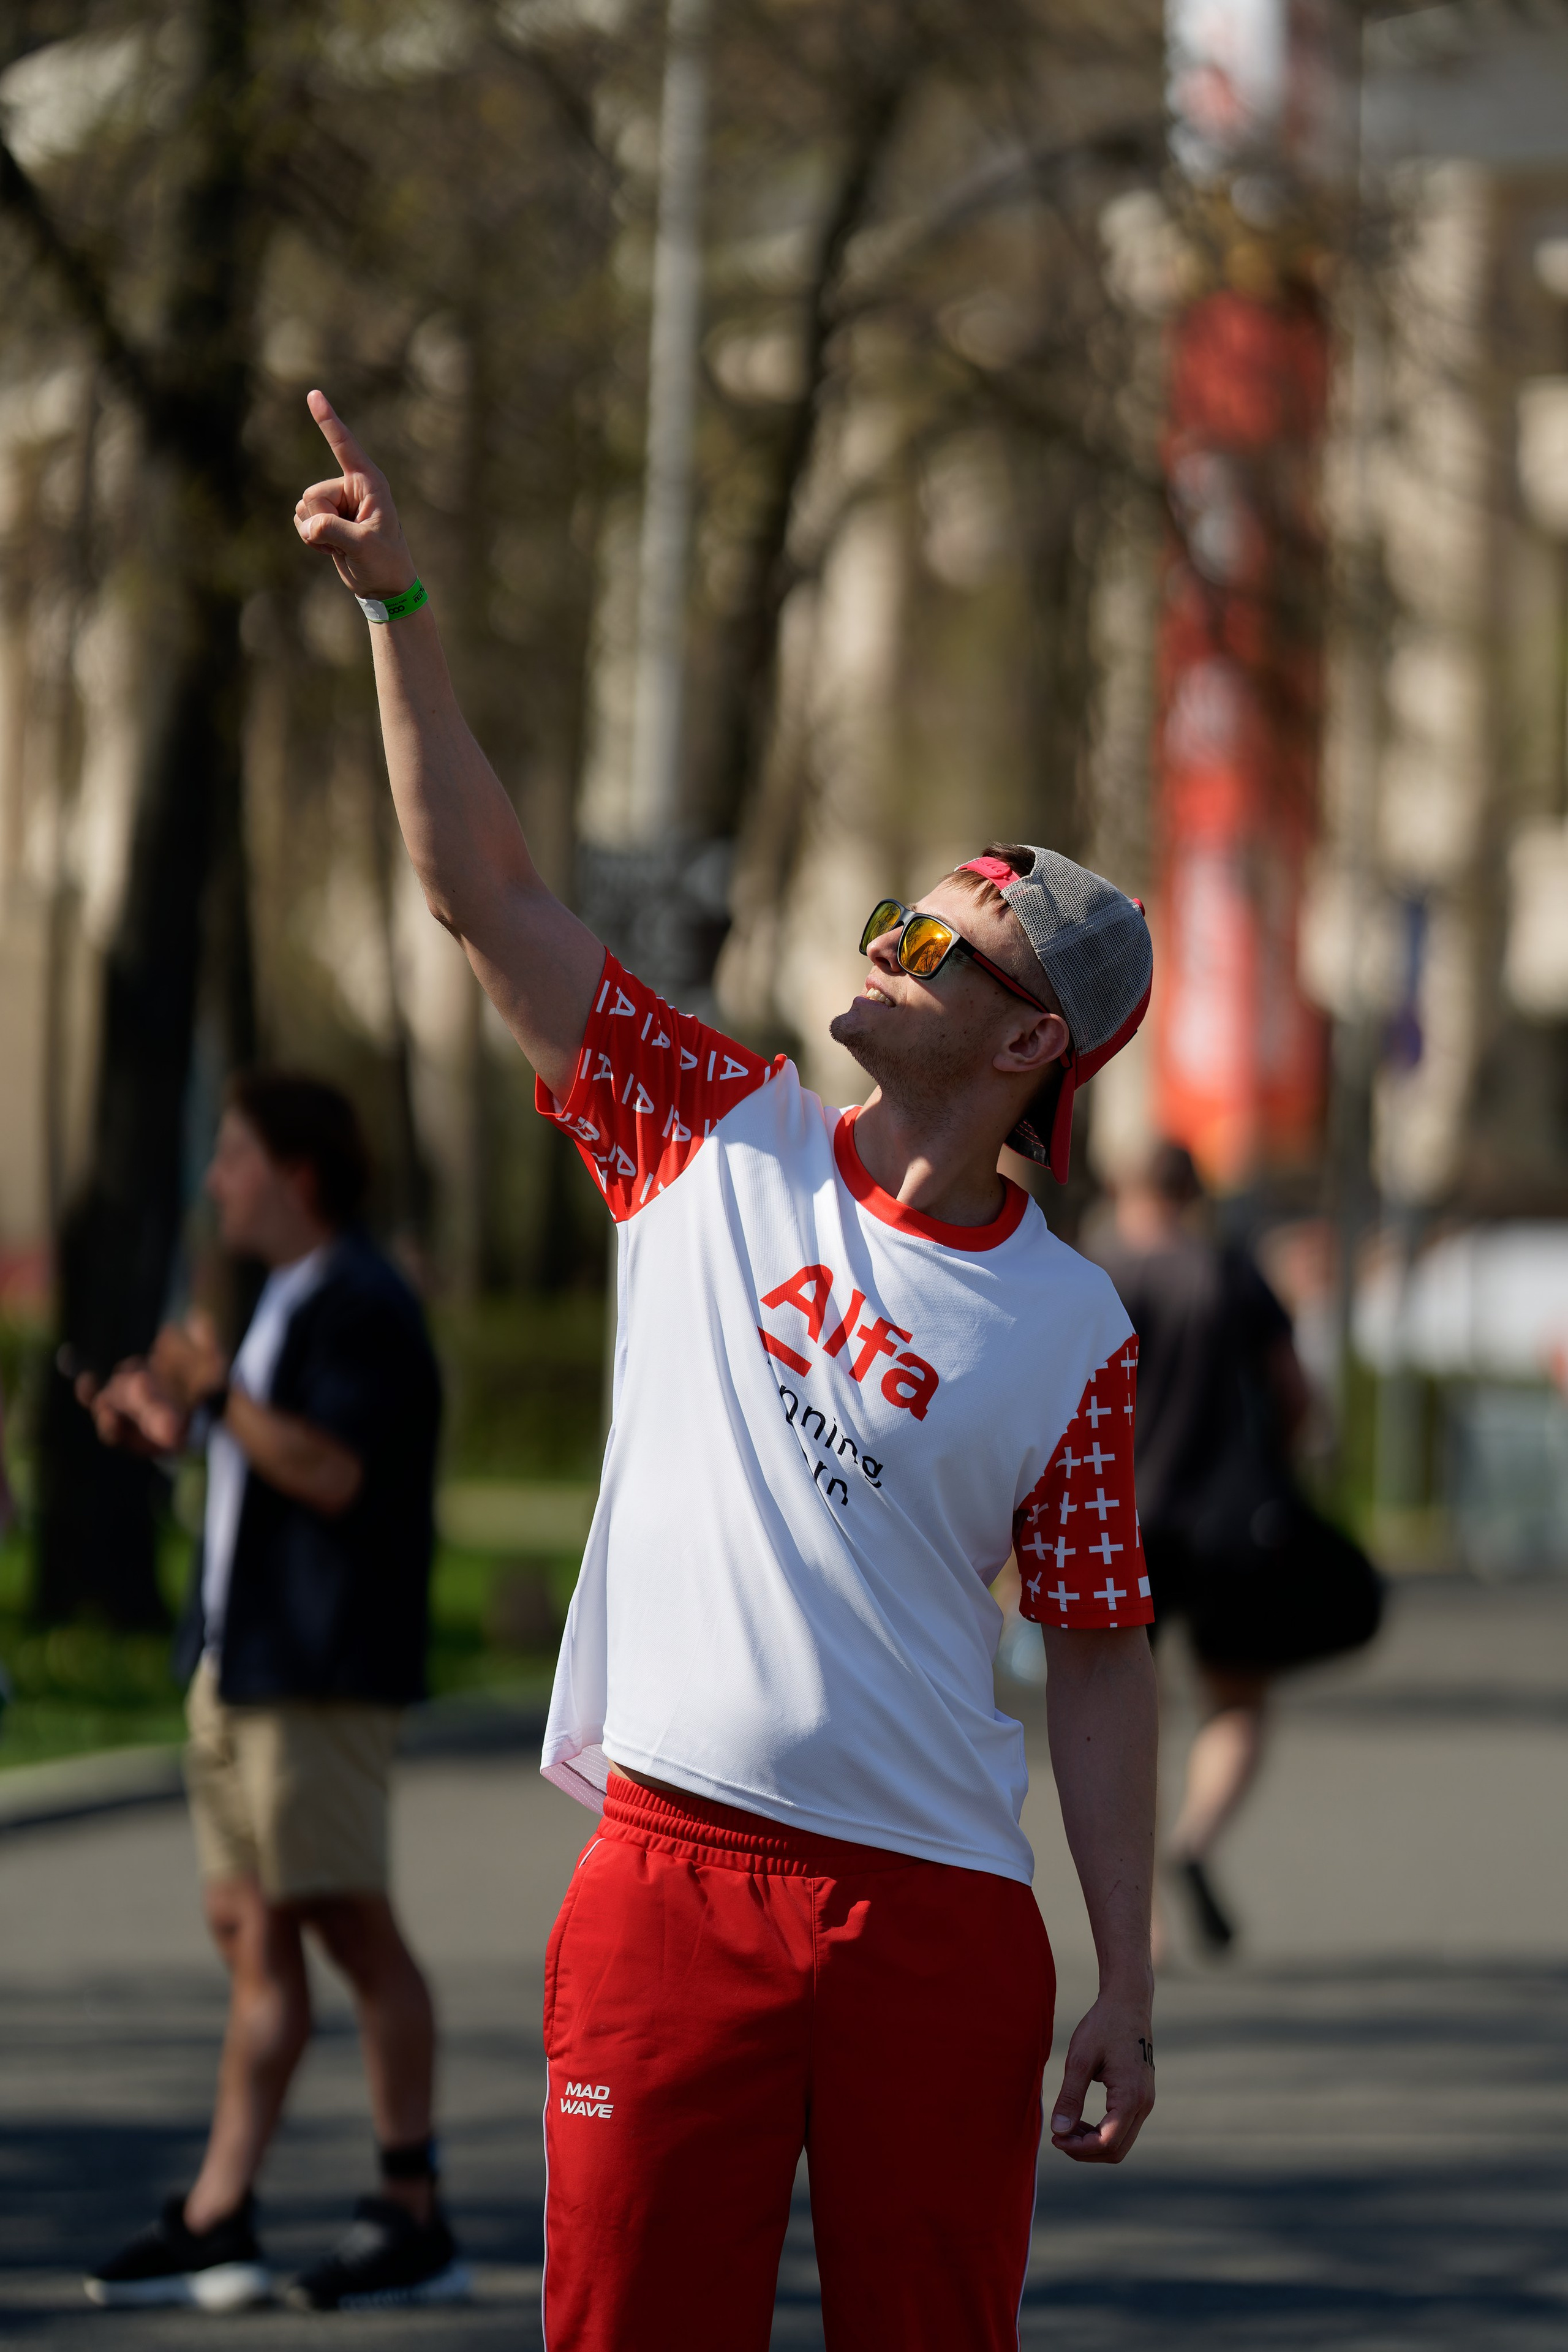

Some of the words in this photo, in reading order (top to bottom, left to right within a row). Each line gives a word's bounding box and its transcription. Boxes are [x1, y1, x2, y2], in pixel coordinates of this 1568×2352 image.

[760, 1264, 939, 1421] Alfa
[779, 1385, 883, 1488] nning
[560, 2098, 614, 2119] WAVE
[565, 2081, 610, 2100] MAD
